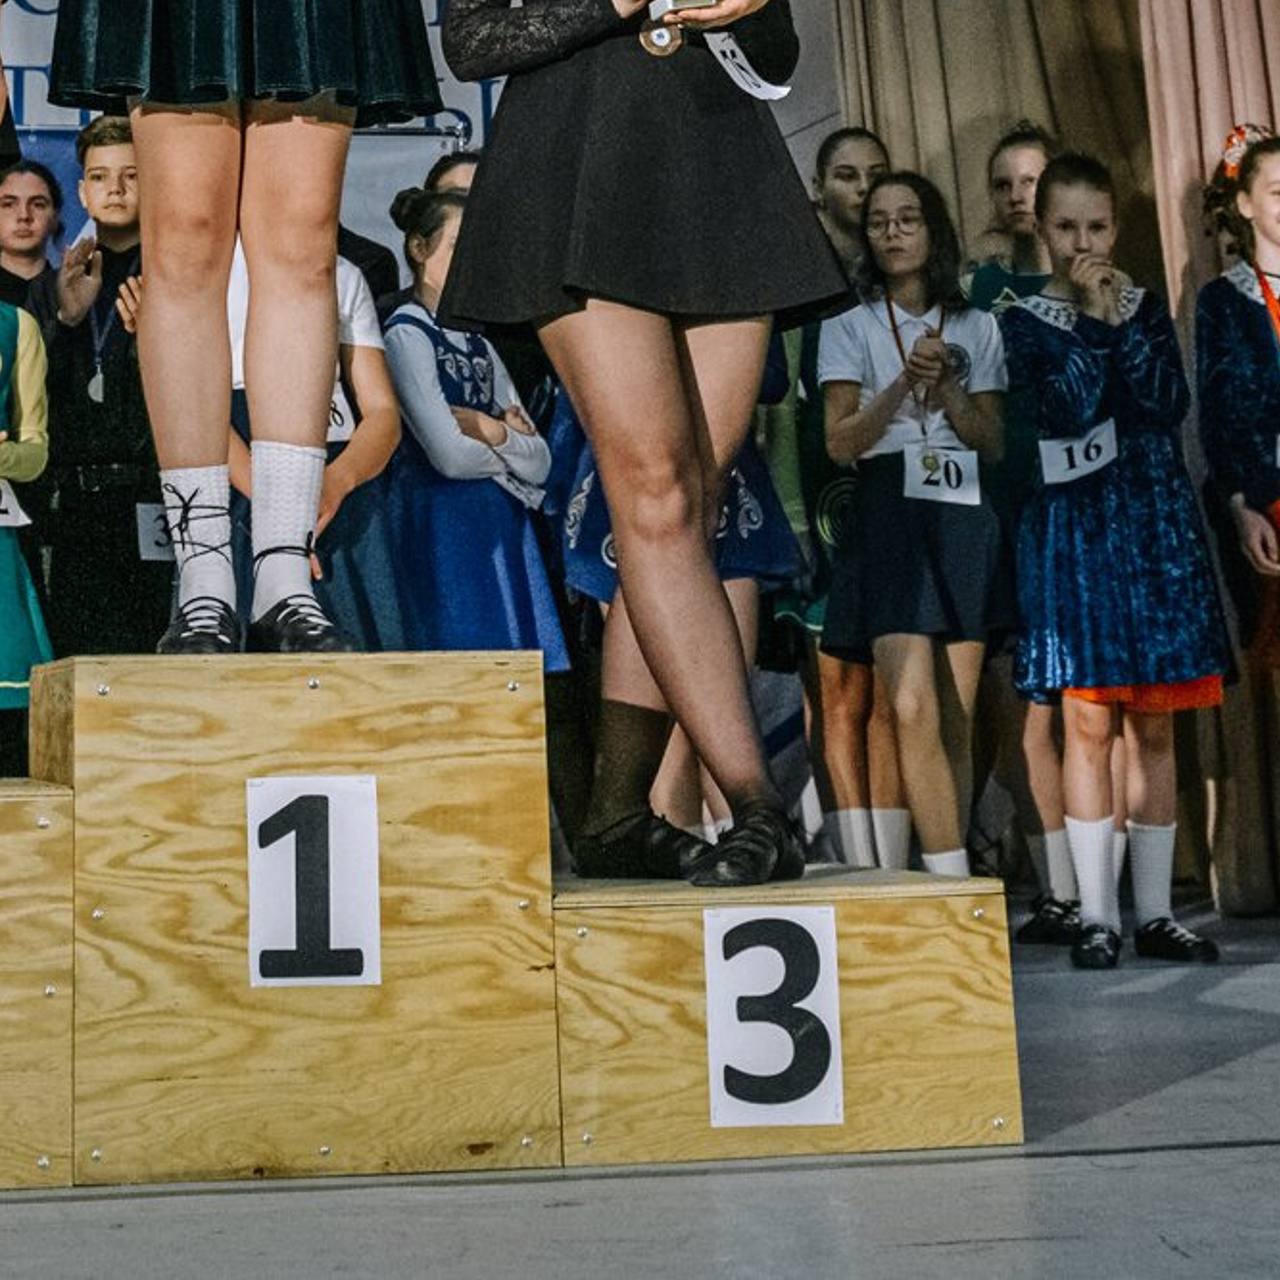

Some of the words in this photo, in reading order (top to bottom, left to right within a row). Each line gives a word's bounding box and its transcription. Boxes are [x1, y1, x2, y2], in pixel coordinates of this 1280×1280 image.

[1063, 433, 1102, 471] 16
[153, 514, 173, 548] 3
[256, 794, 365, 978] 1
[722, 916, 833, 1105] 3
